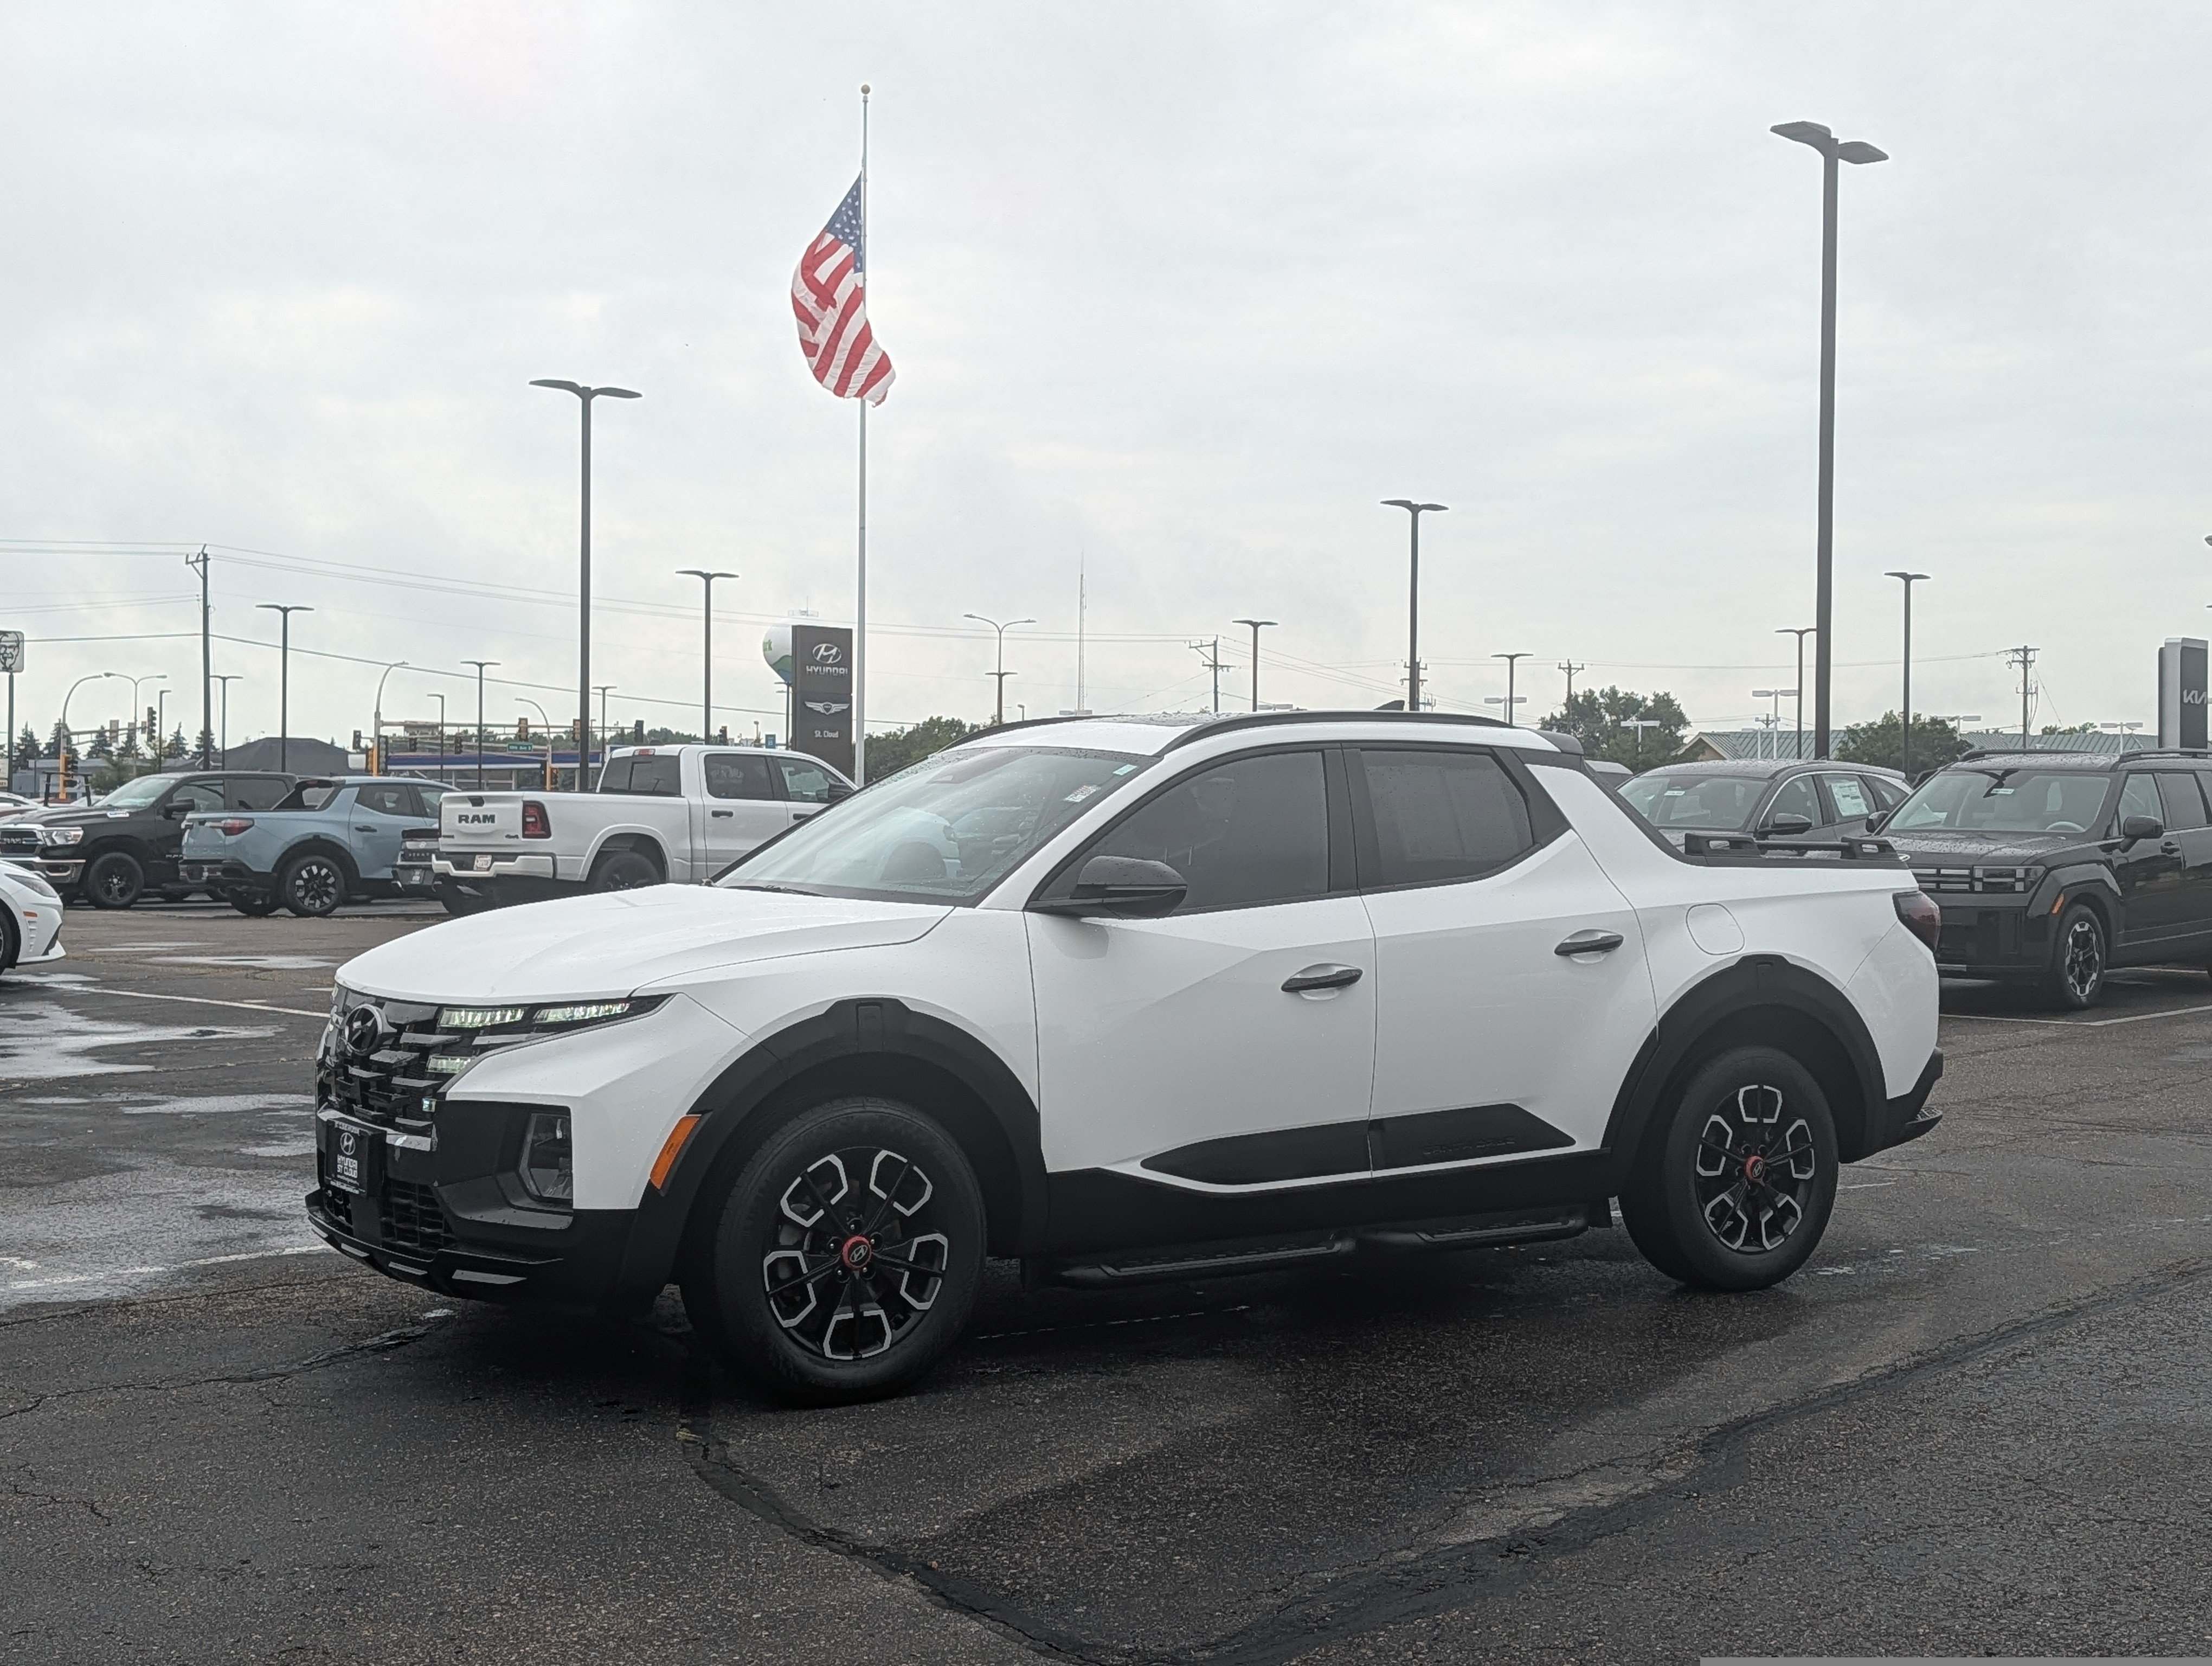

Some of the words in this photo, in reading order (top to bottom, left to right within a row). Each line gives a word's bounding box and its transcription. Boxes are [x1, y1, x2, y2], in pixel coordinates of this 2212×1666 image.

[806, 665, 848, 676] HYUNDAI
[2183, 689, 2207, 705] KIA
[458, 815, 496, 824] RAM
